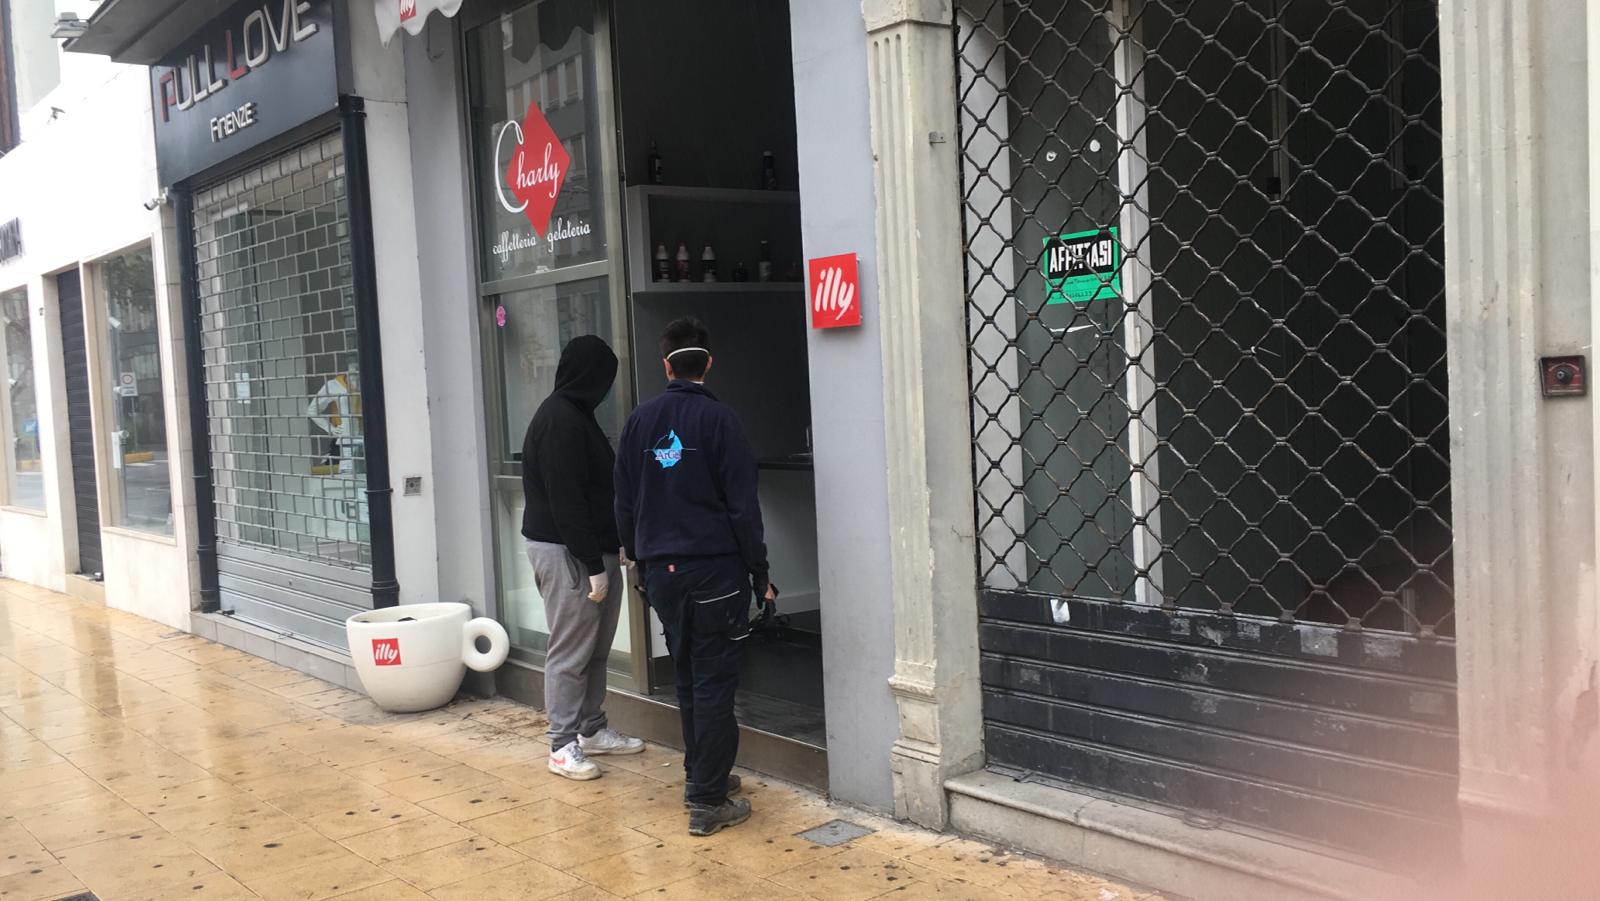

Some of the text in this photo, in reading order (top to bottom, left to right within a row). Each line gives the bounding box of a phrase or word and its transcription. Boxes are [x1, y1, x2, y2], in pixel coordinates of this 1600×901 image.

[159, 0, 318, 122] PULL LOVE
[495, 120, 560, 212] Charly
[492, 217, 592, 263] caffetteria gelateria
[815, 267, 854, 320] illy
[375, 642, 399, 663] illy
